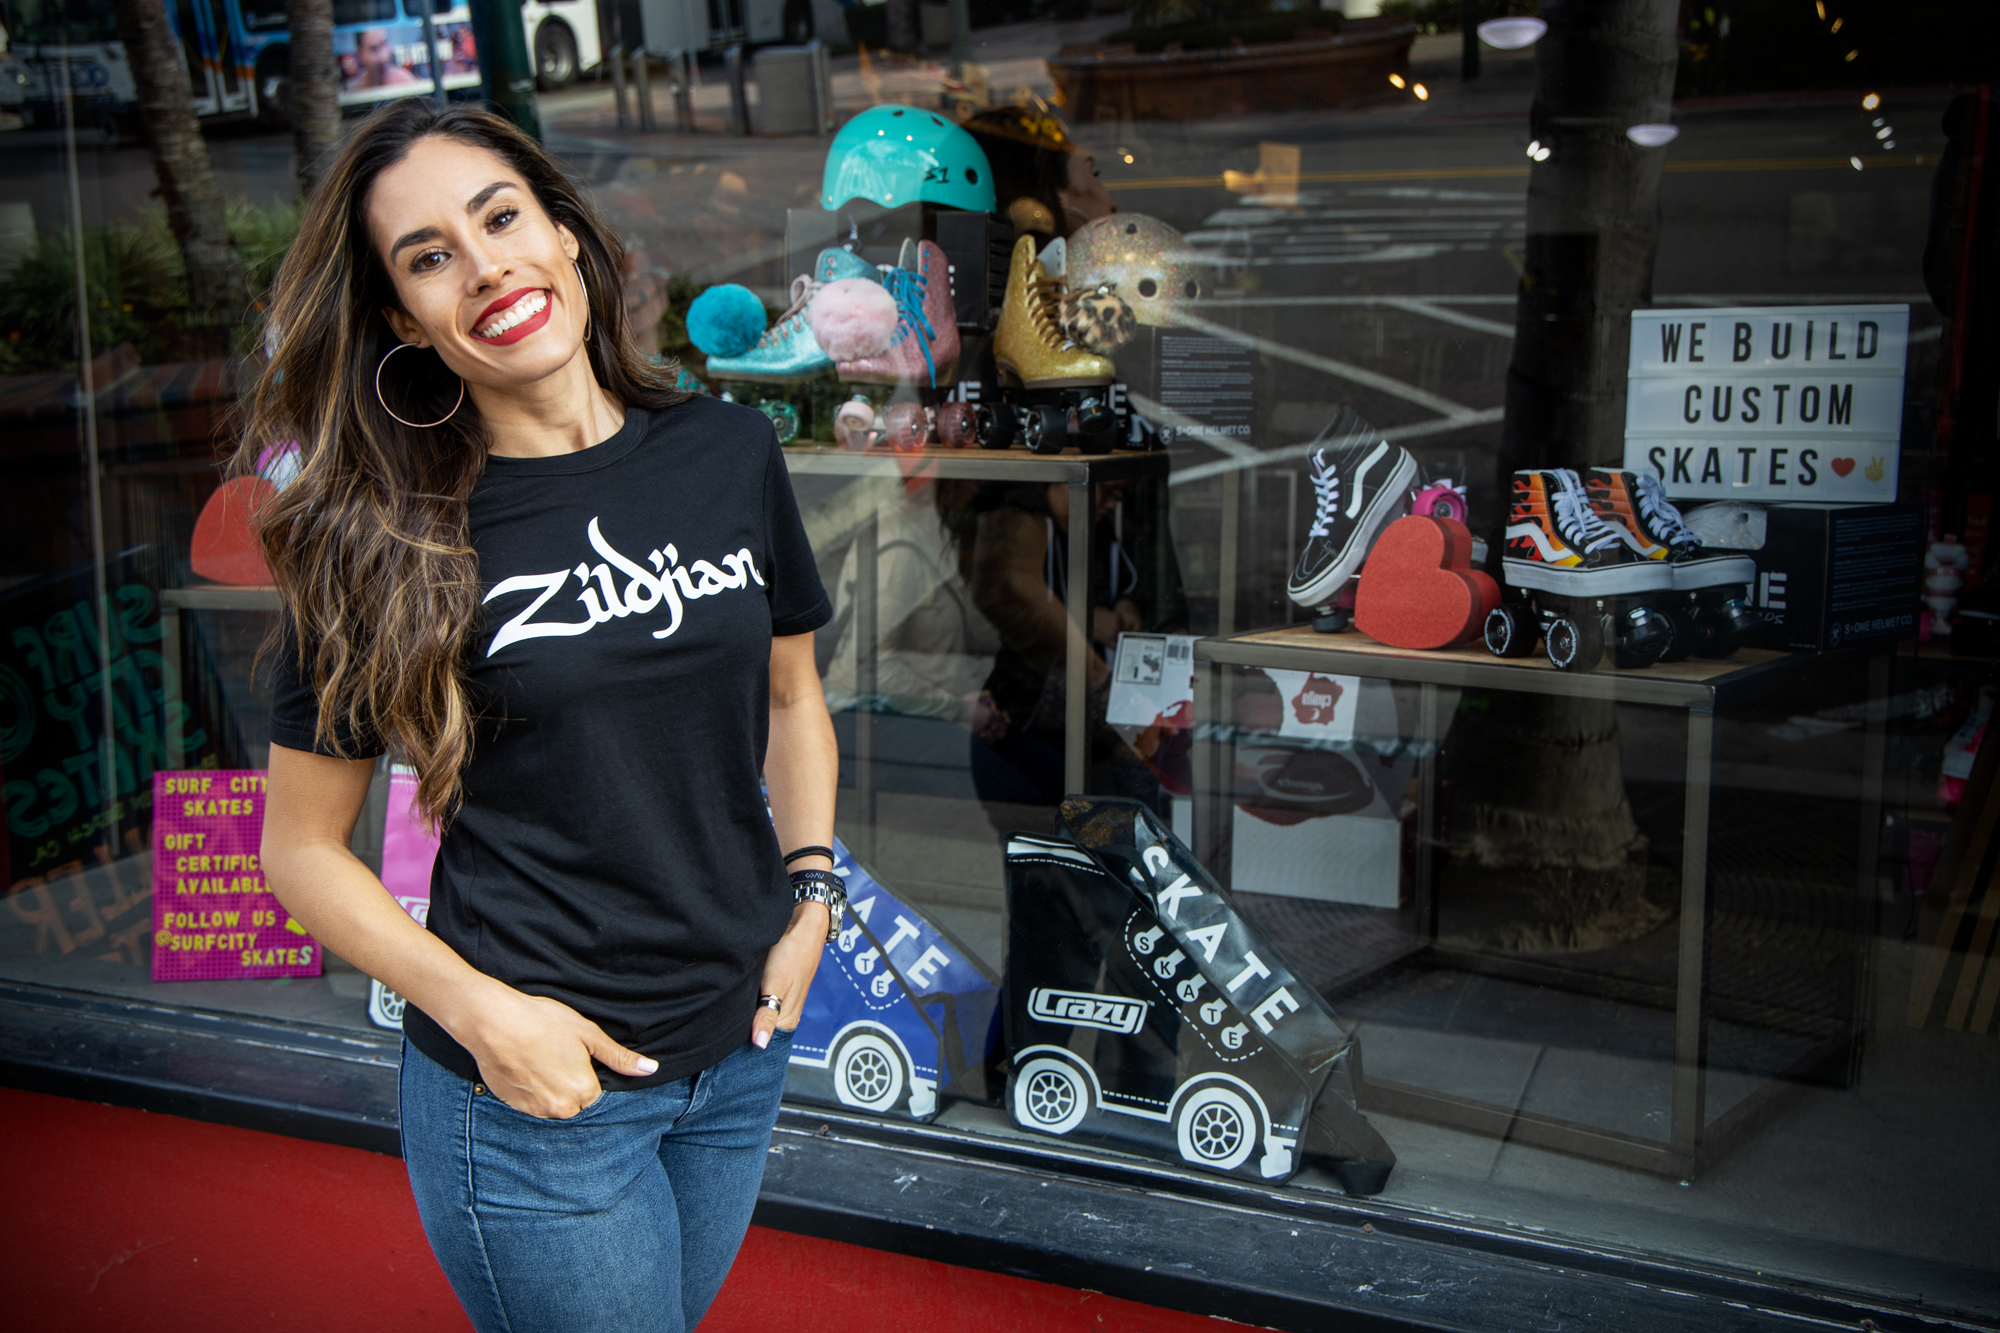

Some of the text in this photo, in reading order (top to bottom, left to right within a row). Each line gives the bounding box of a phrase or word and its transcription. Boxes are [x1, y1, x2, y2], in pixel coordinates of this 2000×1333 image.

[1661, 320, 1879, 362] WE BUILD
[1684, 384, 1853, 425] CUSTOM
[1648, 447, 1818, 485] SKATES
[481, 516, 765, 658] Zildjian
[1871, 616, 1900, 630] HELMET
[165, 776, 212, 795] SURF
[183, 799, 254, 817] SKATES
[164, 833, 206, 851] GIFT
[176, 854, 263, 872] CERTIFIC
[163, 910, 276, 929] FOLLOW US
[155, 929, 258, 951] @SURFCITY
[1128, 845, 1300, 1035] SKATE
[241, 945, 313, 966] SKATES
[1034, 988, 1146, 1034] Crazy
